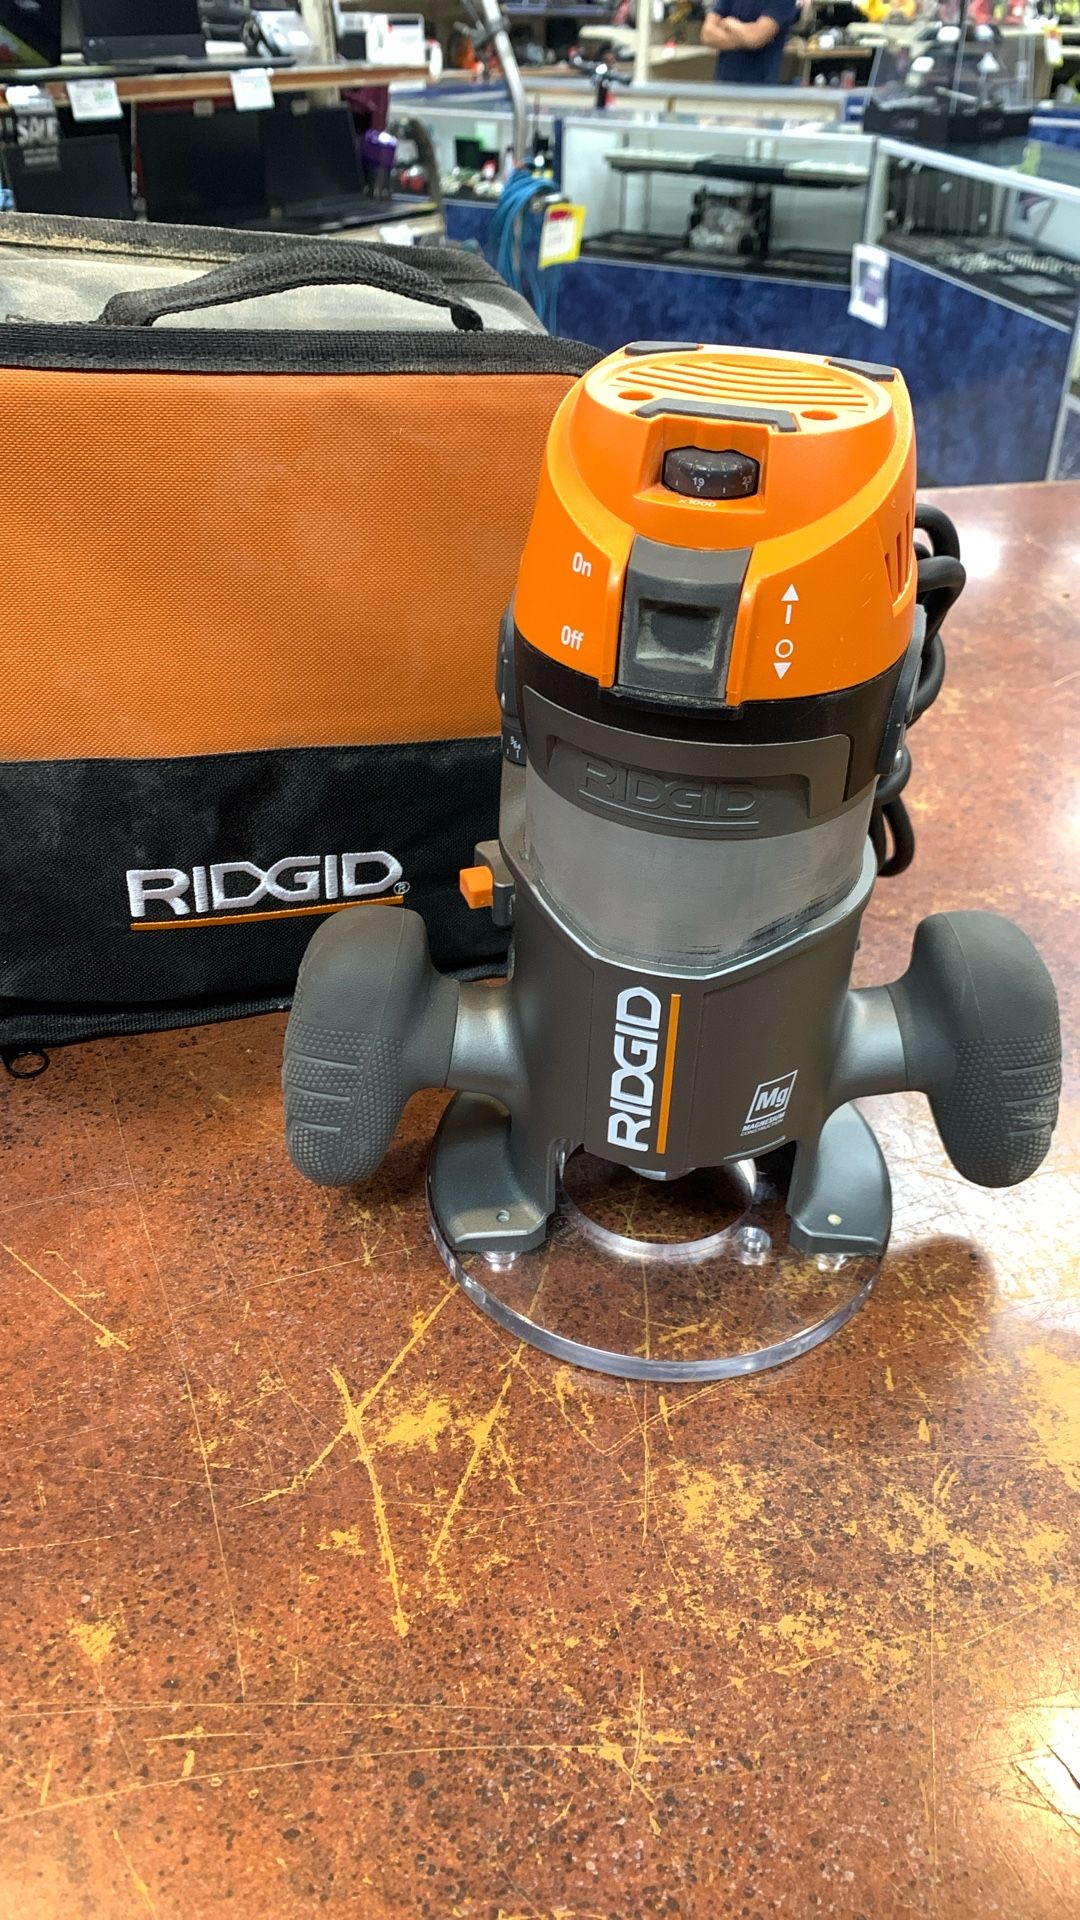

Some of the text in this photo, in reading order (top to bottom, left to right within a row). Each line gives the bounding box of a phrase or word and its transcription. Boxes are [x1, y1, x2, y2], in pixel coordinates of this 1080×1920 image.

[692, 476, 705, 487] 19
[572, 551, 592, 577] On
[561, 625, 584, 651] Off
[580, 760, 760, 818] RIDGID
[607, 986, 662, 1152] RIDGID
[755, 1086, 789, 1111] Mg
[742, 1111, 786, 1132] MAGNESIUM
